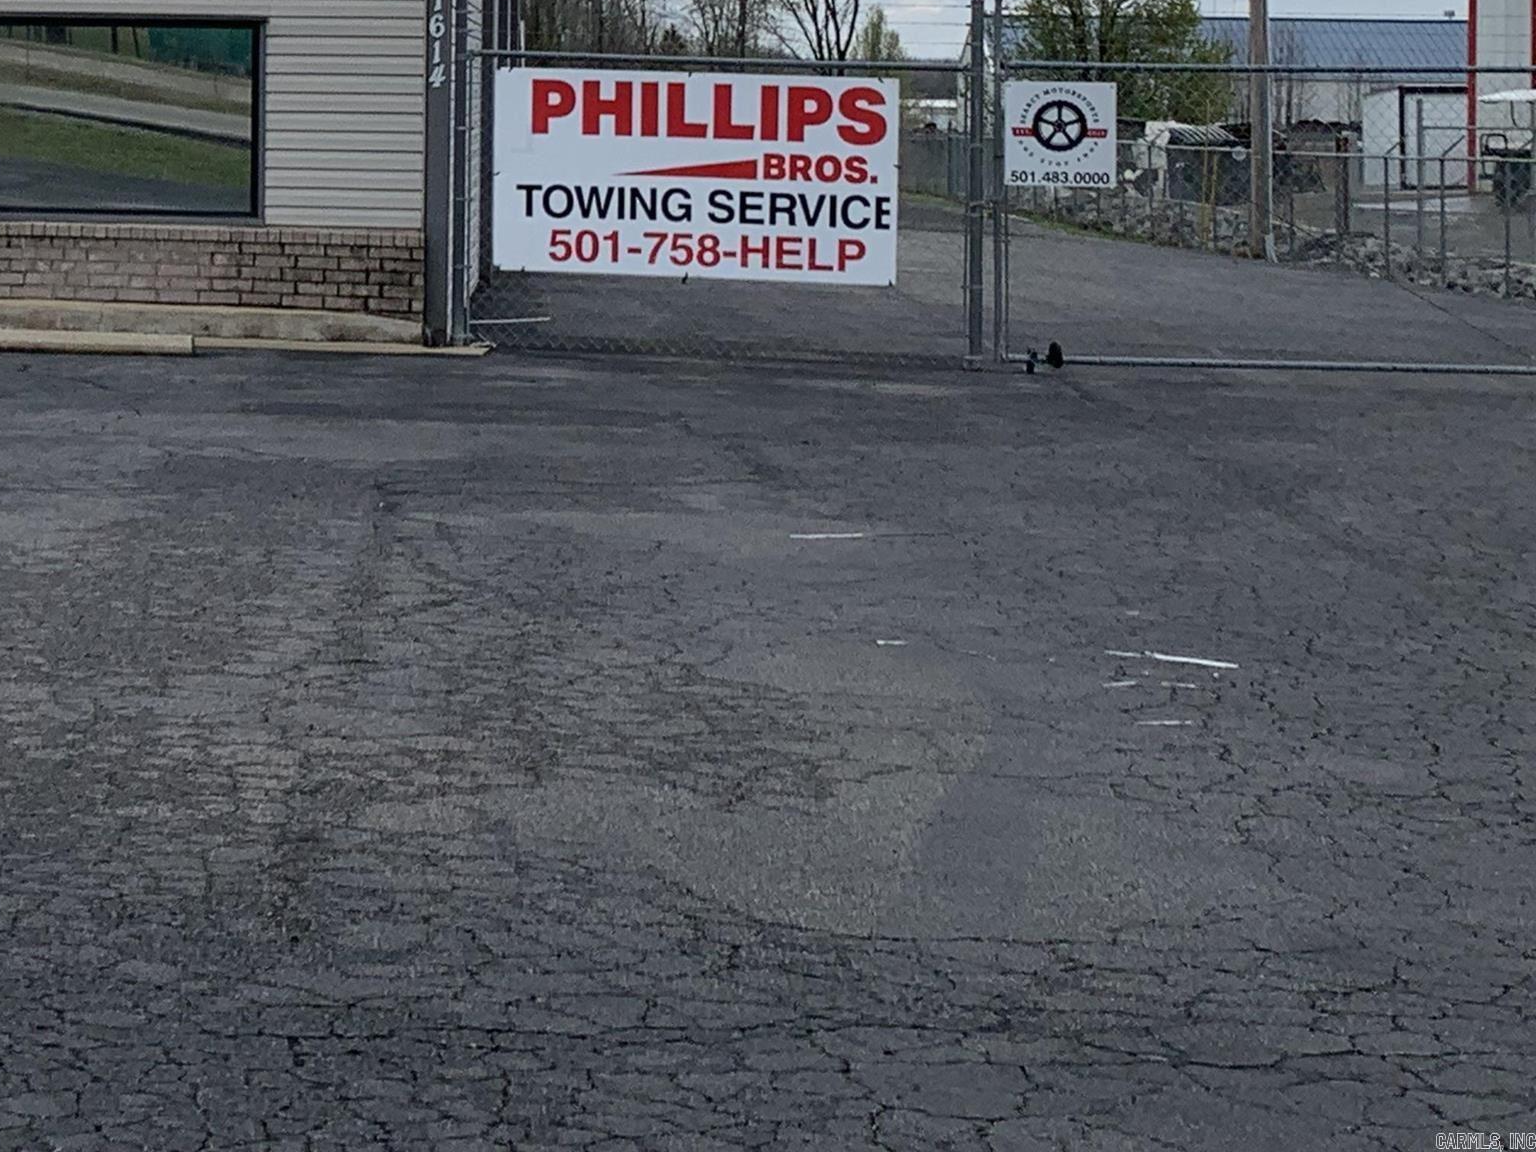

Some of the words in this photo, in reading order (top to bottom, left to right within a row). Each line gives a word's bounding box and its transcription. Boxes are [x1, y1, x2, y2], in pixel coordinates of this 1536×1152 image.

[531, 78, 888, 146] PHILLIPS
[763, 153, 878, 184] BROS.
[1010, 170, 1110, 184] 501.483.0000
[516, 183, 693, 222] TOWING
[707, 188, 891, 230] SERVICE
[548, 229, 866, 272] 501-758-HELP
